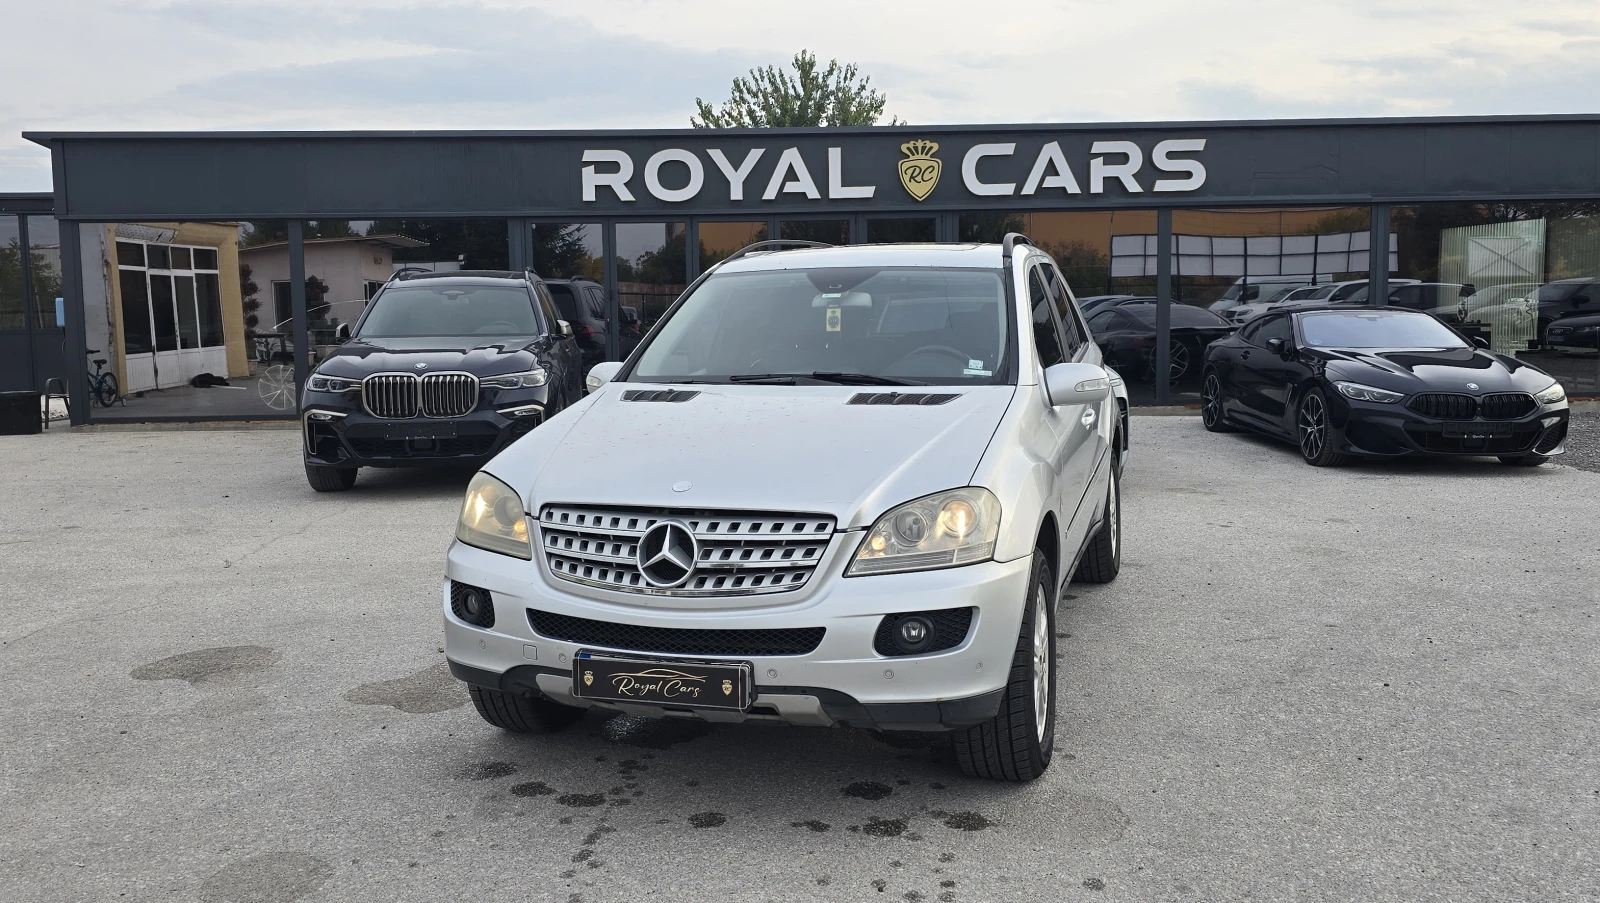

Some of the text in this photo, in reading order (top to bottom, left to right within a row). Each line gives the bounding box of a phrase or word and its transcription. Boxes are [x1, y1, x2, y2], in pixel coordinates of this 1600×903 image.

[581, 138, 1207, 202] ROYAL RC CARS
[612, 676, 702, 698] Royal Cars
